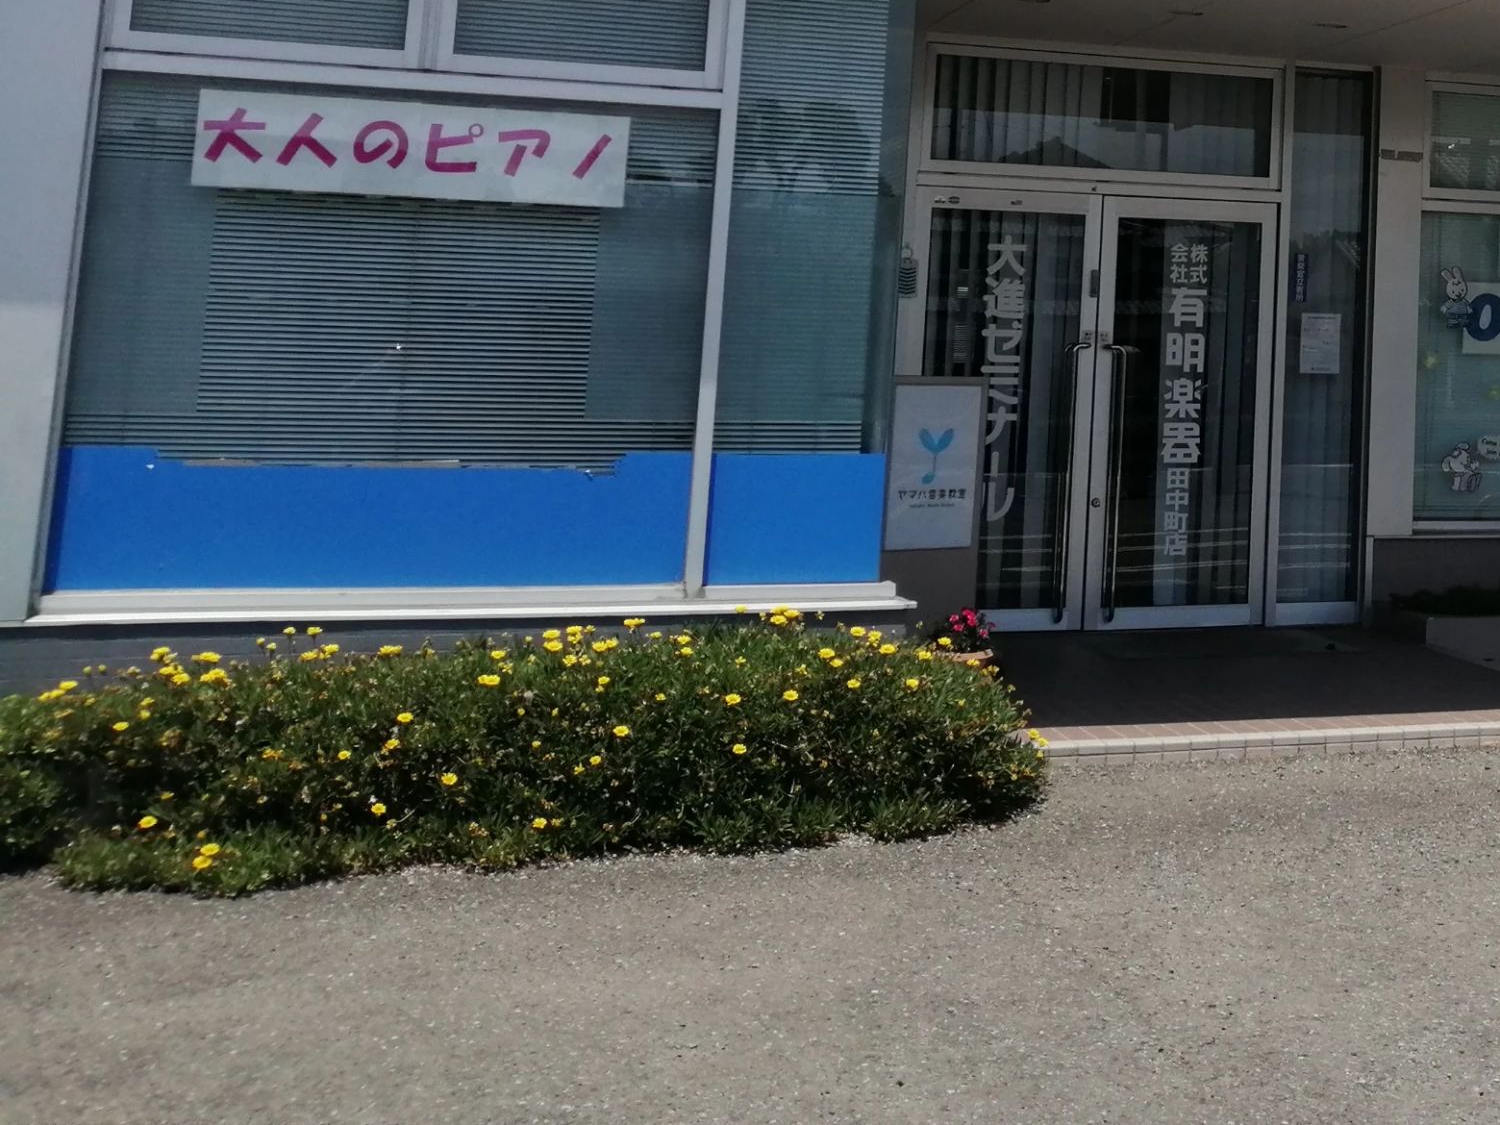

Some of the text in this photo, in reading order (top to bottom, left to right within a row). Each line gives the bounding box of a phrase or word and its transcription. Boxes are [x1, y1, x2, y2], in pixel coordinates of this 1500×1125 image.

[203, 107, 612, 179] 大人のピアノ
[981, 234, 1028, 523] 大進ゼミナール
